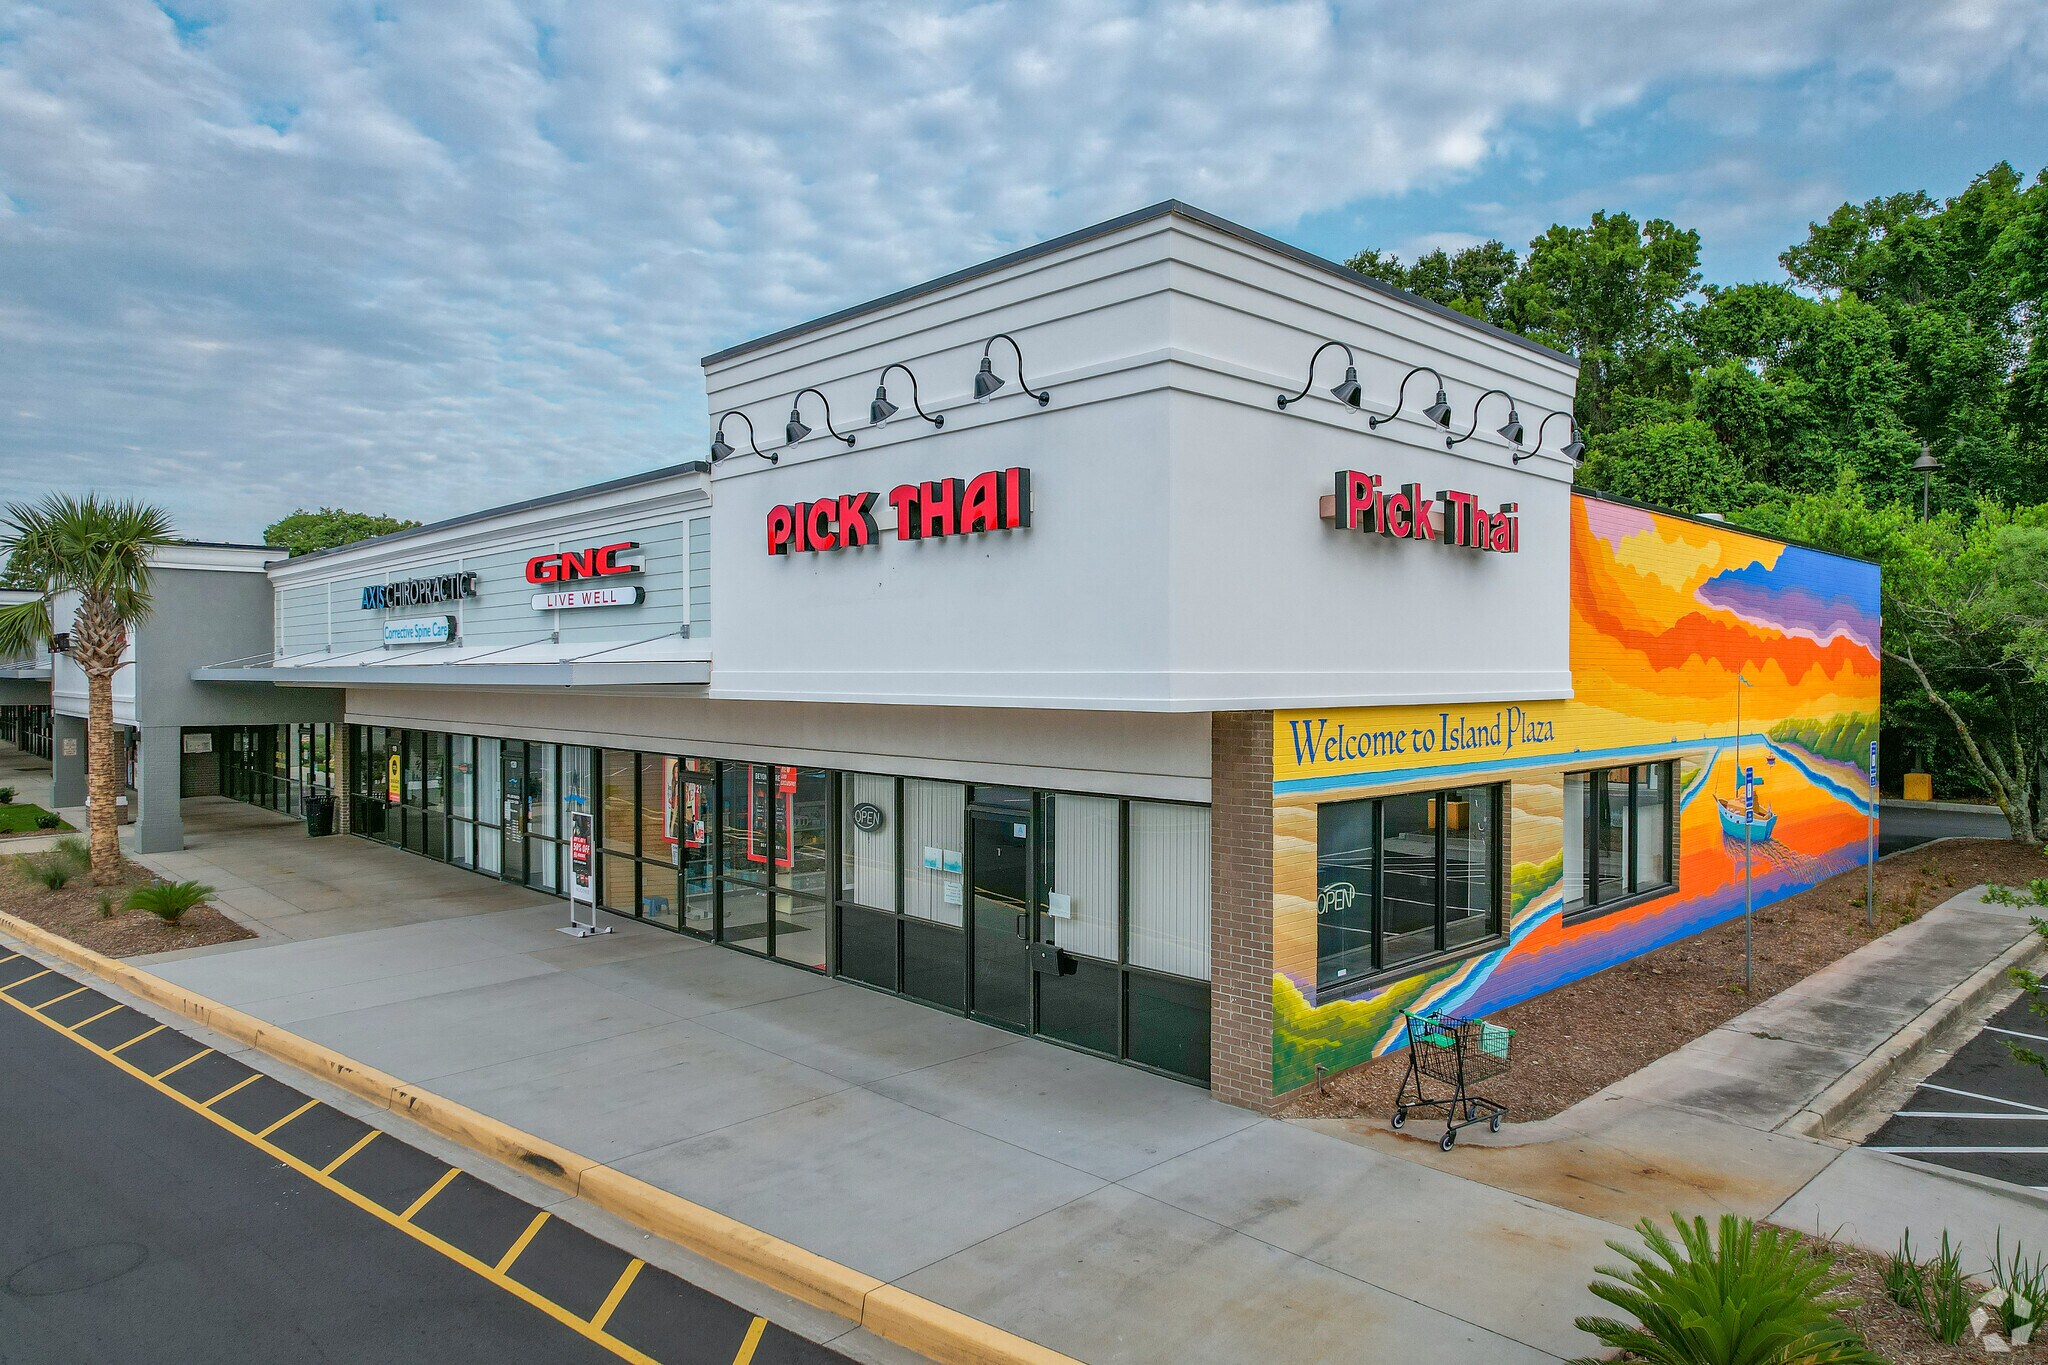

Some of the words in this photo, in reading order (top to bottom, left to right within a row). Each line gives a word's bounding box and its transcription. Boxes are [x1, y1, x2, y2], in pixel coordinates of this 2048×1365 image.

[767, 491, 875, 555] PICK
[888, 467, 1025, 541] THAI
[1344, 470, 1436, 541] Pick
[1445, 490, 1519, 553] Thai
[525, 542, 635, 584] GNC
[361, 585, 385, 609] AXIS
[385, 571, 471, 608] CHIROPRACTIC
[547, 593, 574, 607] LIVE
[582, 589, 617, 605] WELL
[384, 625, 414, 640] Corrective
[414, 623, 431, 639] Spine
[432, 621, 448, 637] Care
[1289, 718, 1407, 766] Welcome
[1411, 727, 1436, 753] to
[1439, 712, 1502, 752] Island
[1502, 705, 1555, 756] Plaza
[855, 809, 880, 825] OPEN
[1317, 887, 1352, 914] OPEN
